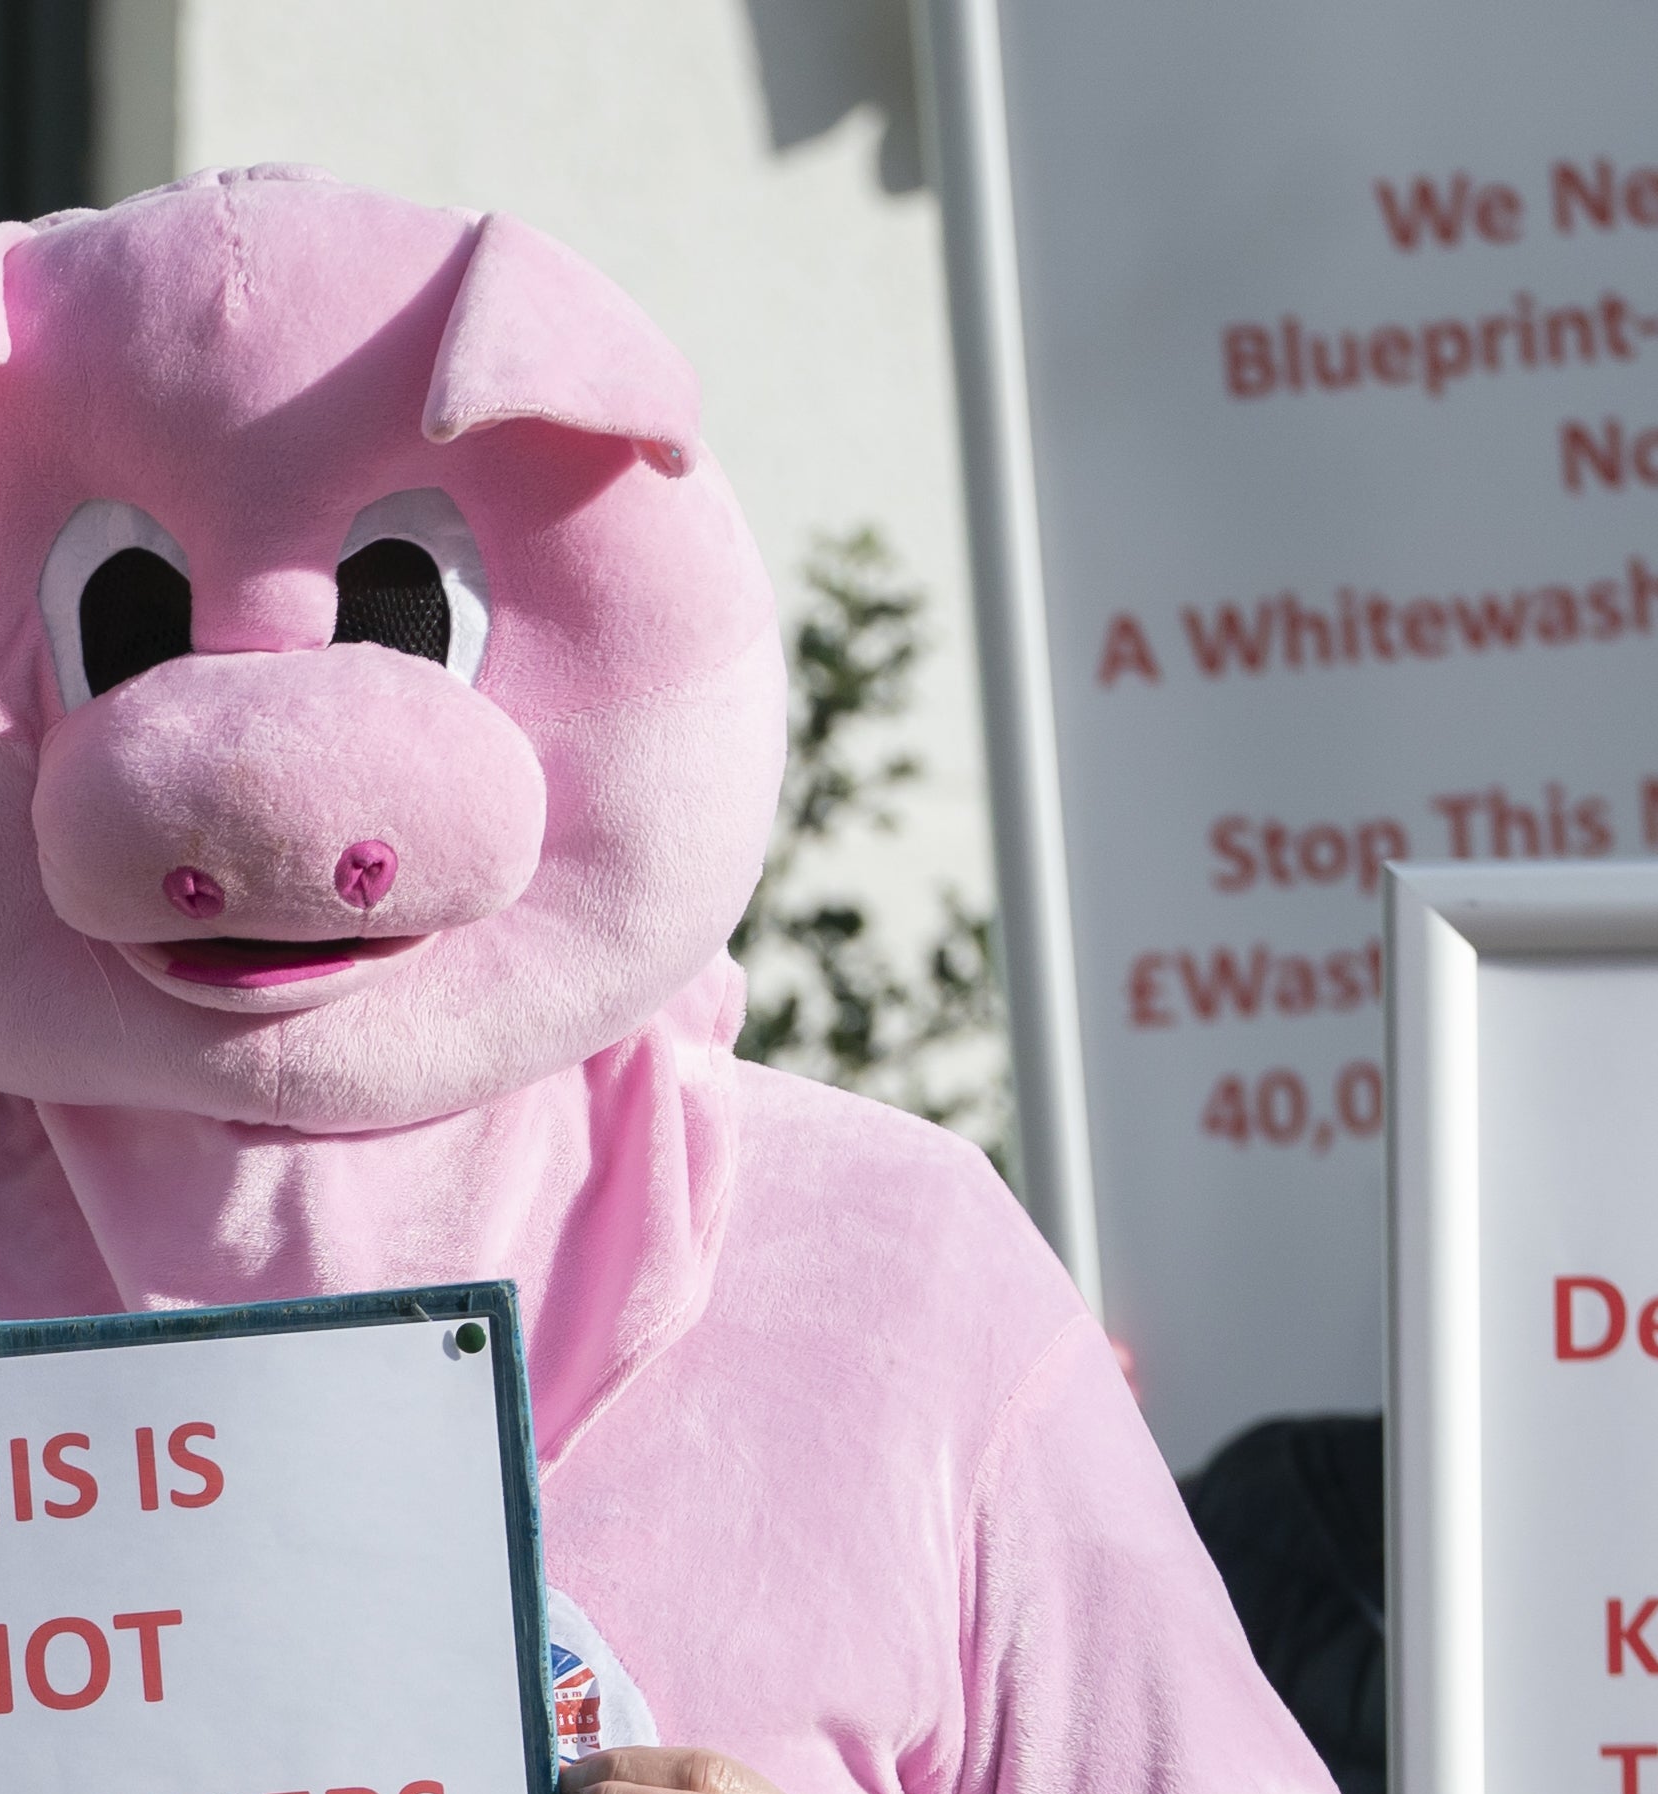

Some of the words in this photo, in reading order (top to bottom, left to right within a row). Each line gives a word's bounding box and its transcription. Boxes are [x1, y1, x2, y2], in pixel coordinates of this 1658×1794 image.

[1374, 170, 1524, 254] We
[1096, 610, 1163, 688] A
[1208, 814, 1410, 895] Stop
[1432, 783, 1615, 860] This
[135, 1422, 224, 1511] IS
